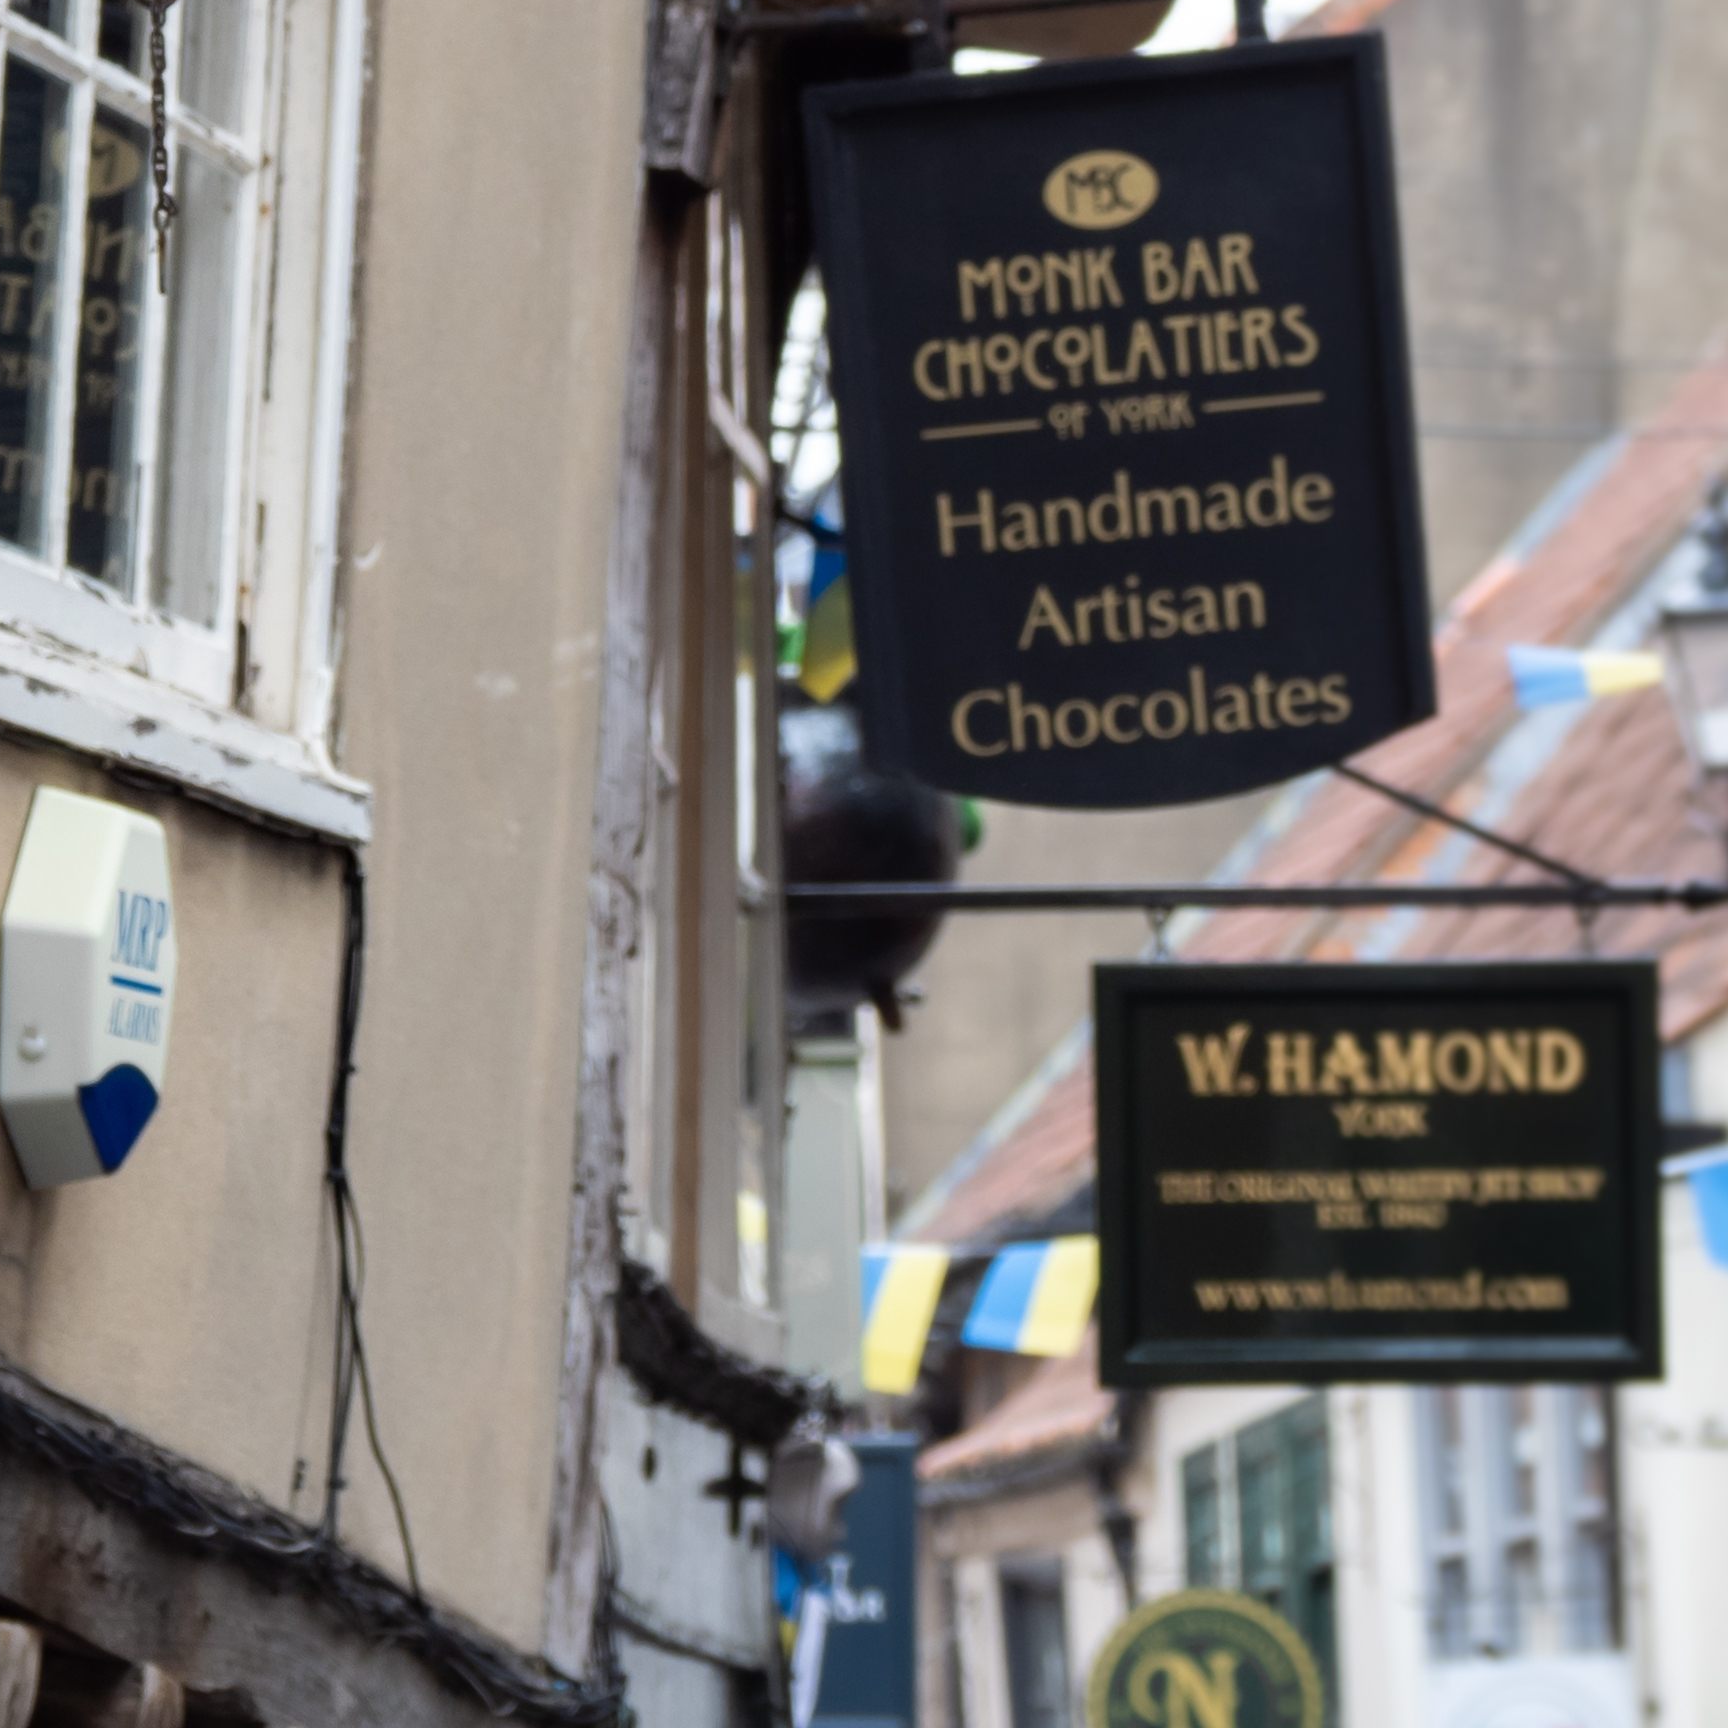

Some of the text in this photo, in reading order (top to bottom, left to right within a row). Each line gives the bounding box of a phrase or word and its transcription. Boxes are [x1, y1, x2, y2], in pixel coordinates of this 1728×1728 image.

[959, 234, 1257, 319] MONK BAR
[913, 304, 1321, 402] CHOCOLATIERS
[1049, 394, 1193, 436] OF YORK
[937, 456, 1332, 555] Handmade
[1020, 576, 1265, 648] Artisan
[952, 667, 1352, 756] Chocolates
[1177, 1021, 1586, 1096] W. HAMOND
[1332, 1100, 1427, 1137] YORK
[1218, 1170, 1355, 1204] ORIGINAL
